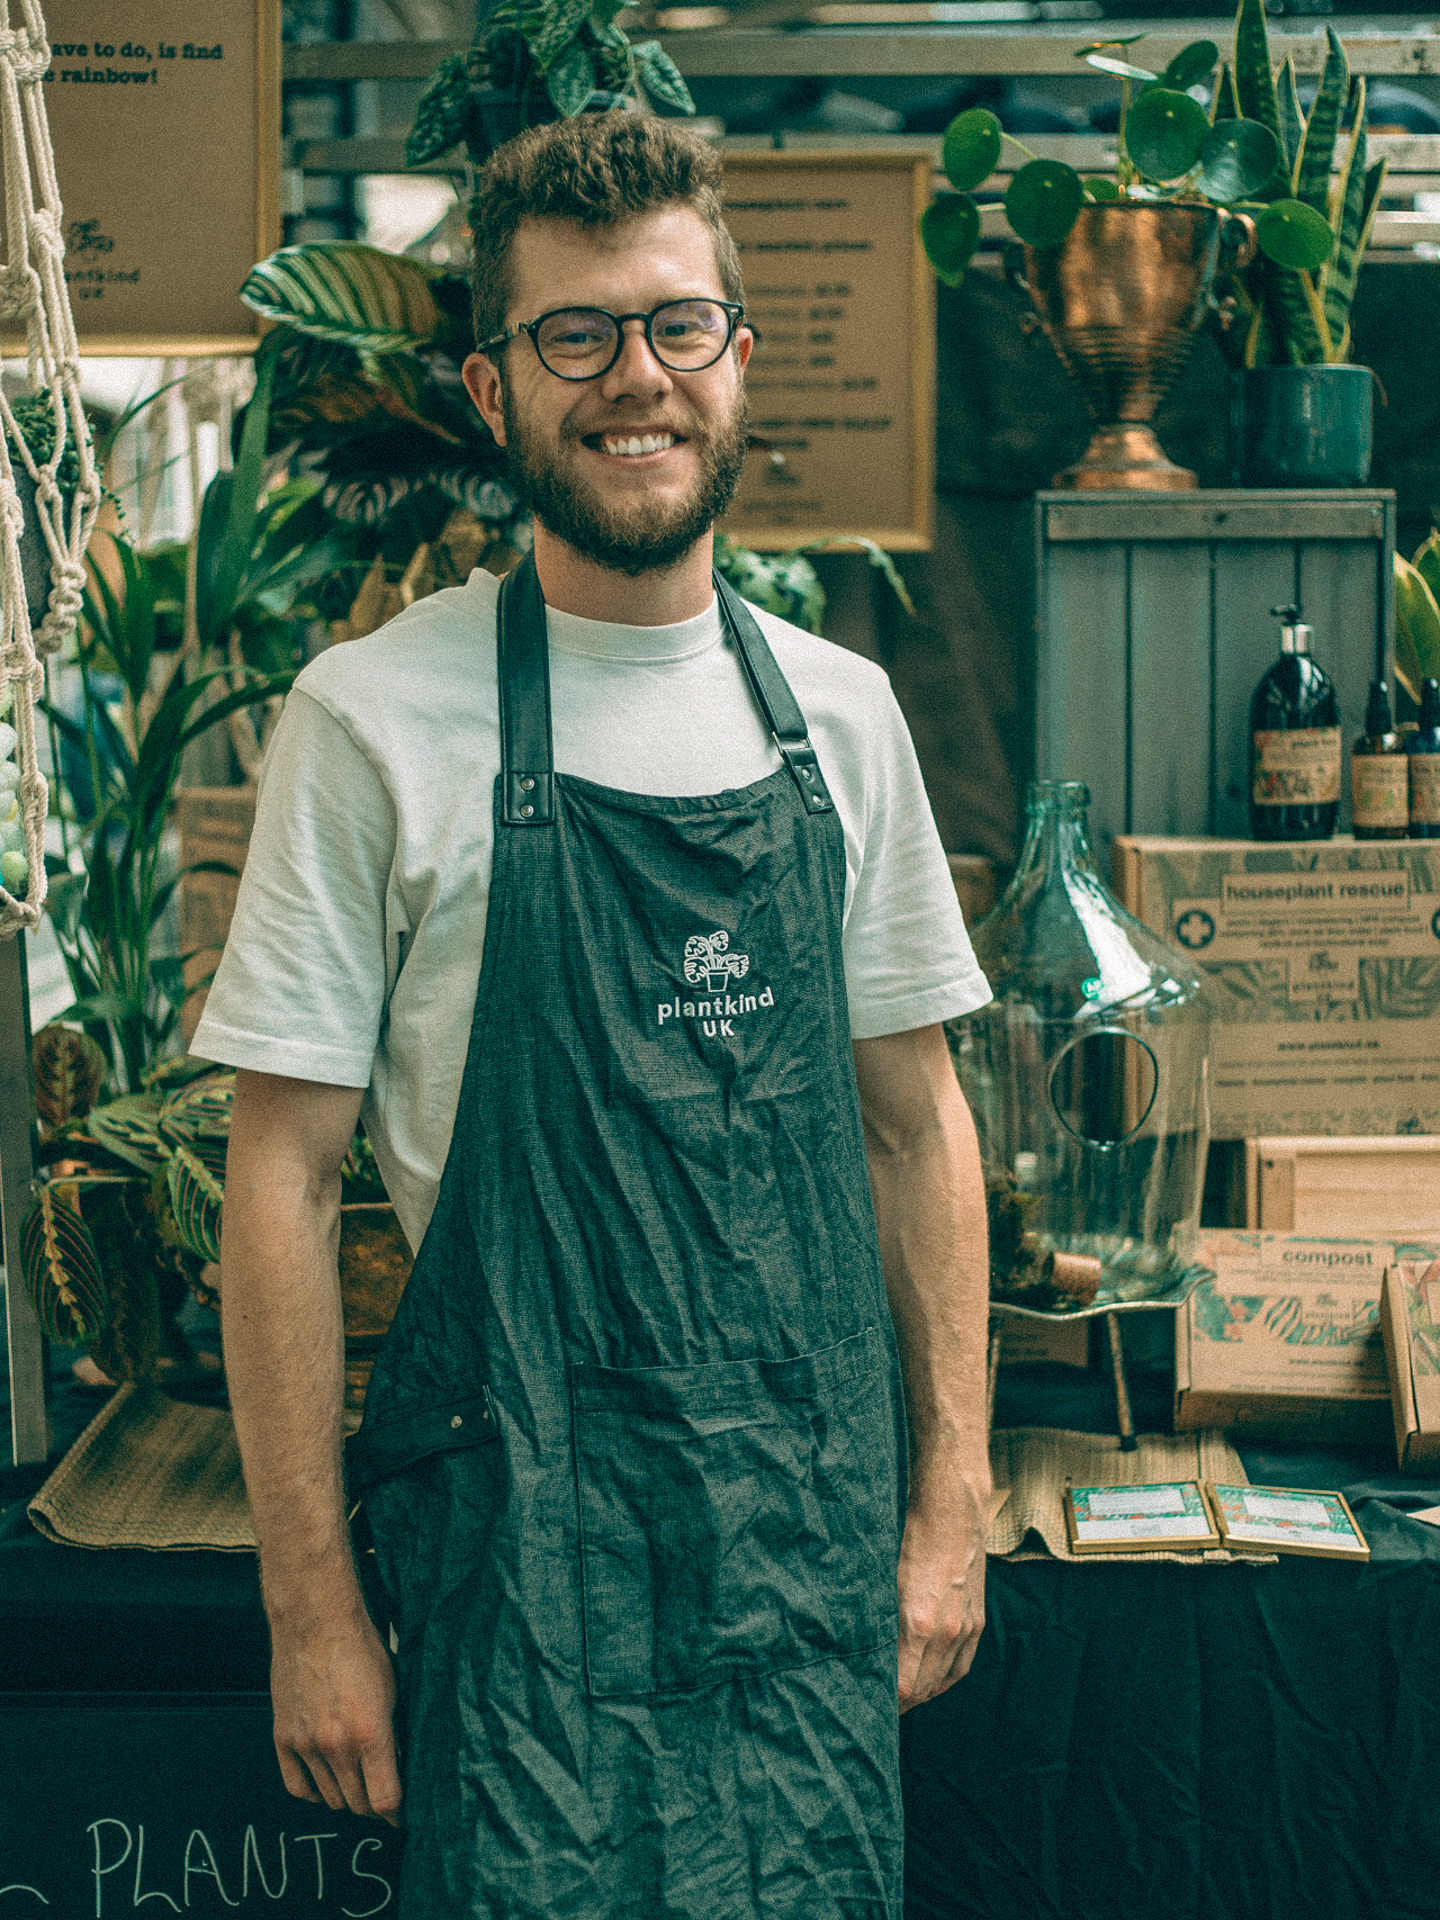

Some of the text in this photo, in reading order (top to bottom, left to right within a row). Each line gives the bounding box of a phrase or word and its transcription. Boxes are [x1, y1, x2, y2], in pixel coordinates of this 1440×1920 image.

[51, 42, 223, 62] ave to do, is find
[42, 67, 157, 84] e rainbow!
[1227, 883, 1405, 901] houseplant rescue
[657, 986, 775, 1025] plantkind
[703, 1019, 735, 1038] UK
[1281, 1250, 1374, 1268] compost
[86, 1818, 391, 1918] PLANTS
